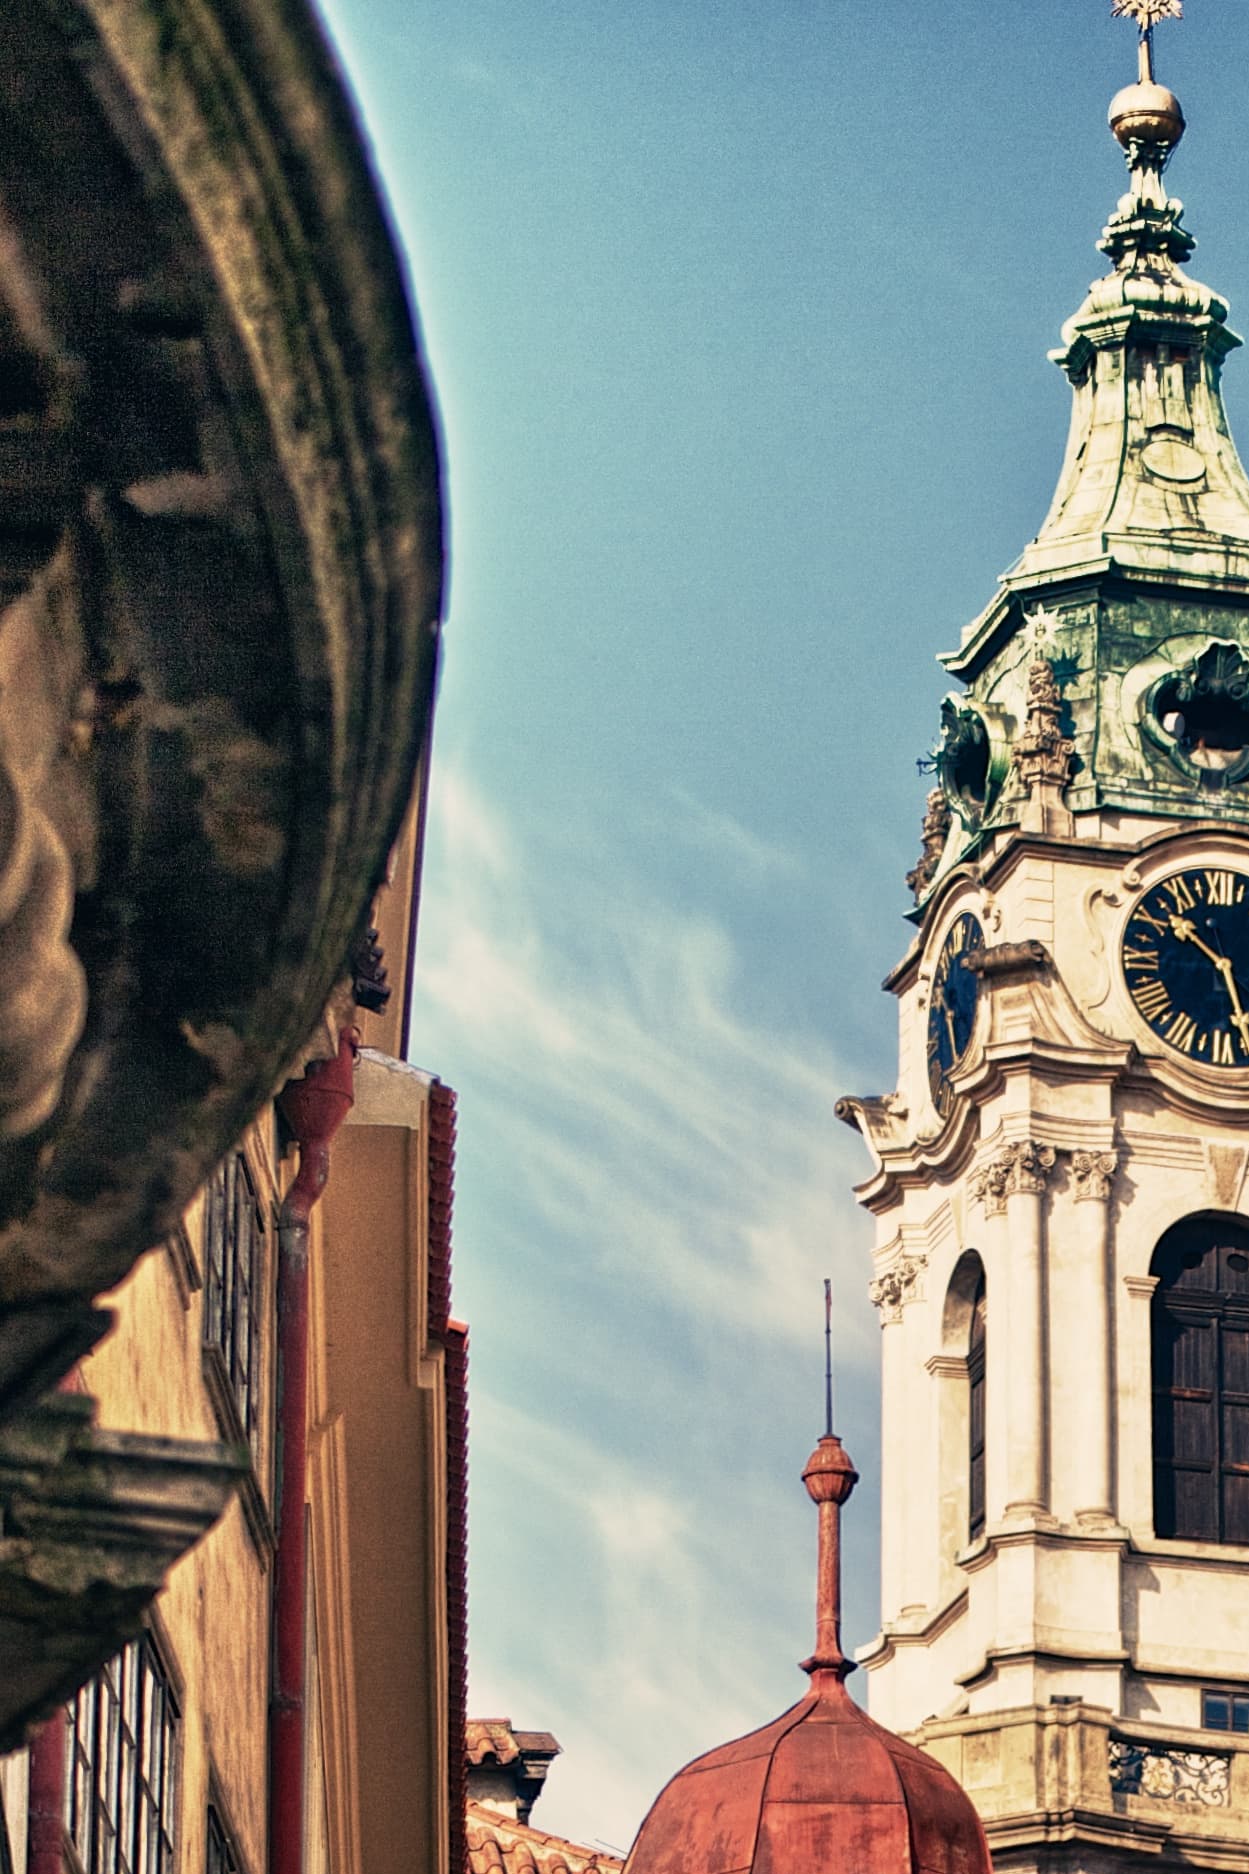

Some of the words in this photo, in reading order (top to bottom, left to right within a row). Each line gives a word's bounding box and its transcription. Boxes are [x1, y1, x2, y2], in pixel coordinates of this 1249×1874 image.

[1163, 875, 1196, 915] XI
[1204, 871, 1235, 906] XII
[1133, 904, 1169, 937] X
[1124, 944, 1159, 970] IX
[1164, 1011, 1198, 1053] VII
[1212, 1028, 1236, 1065] VI
